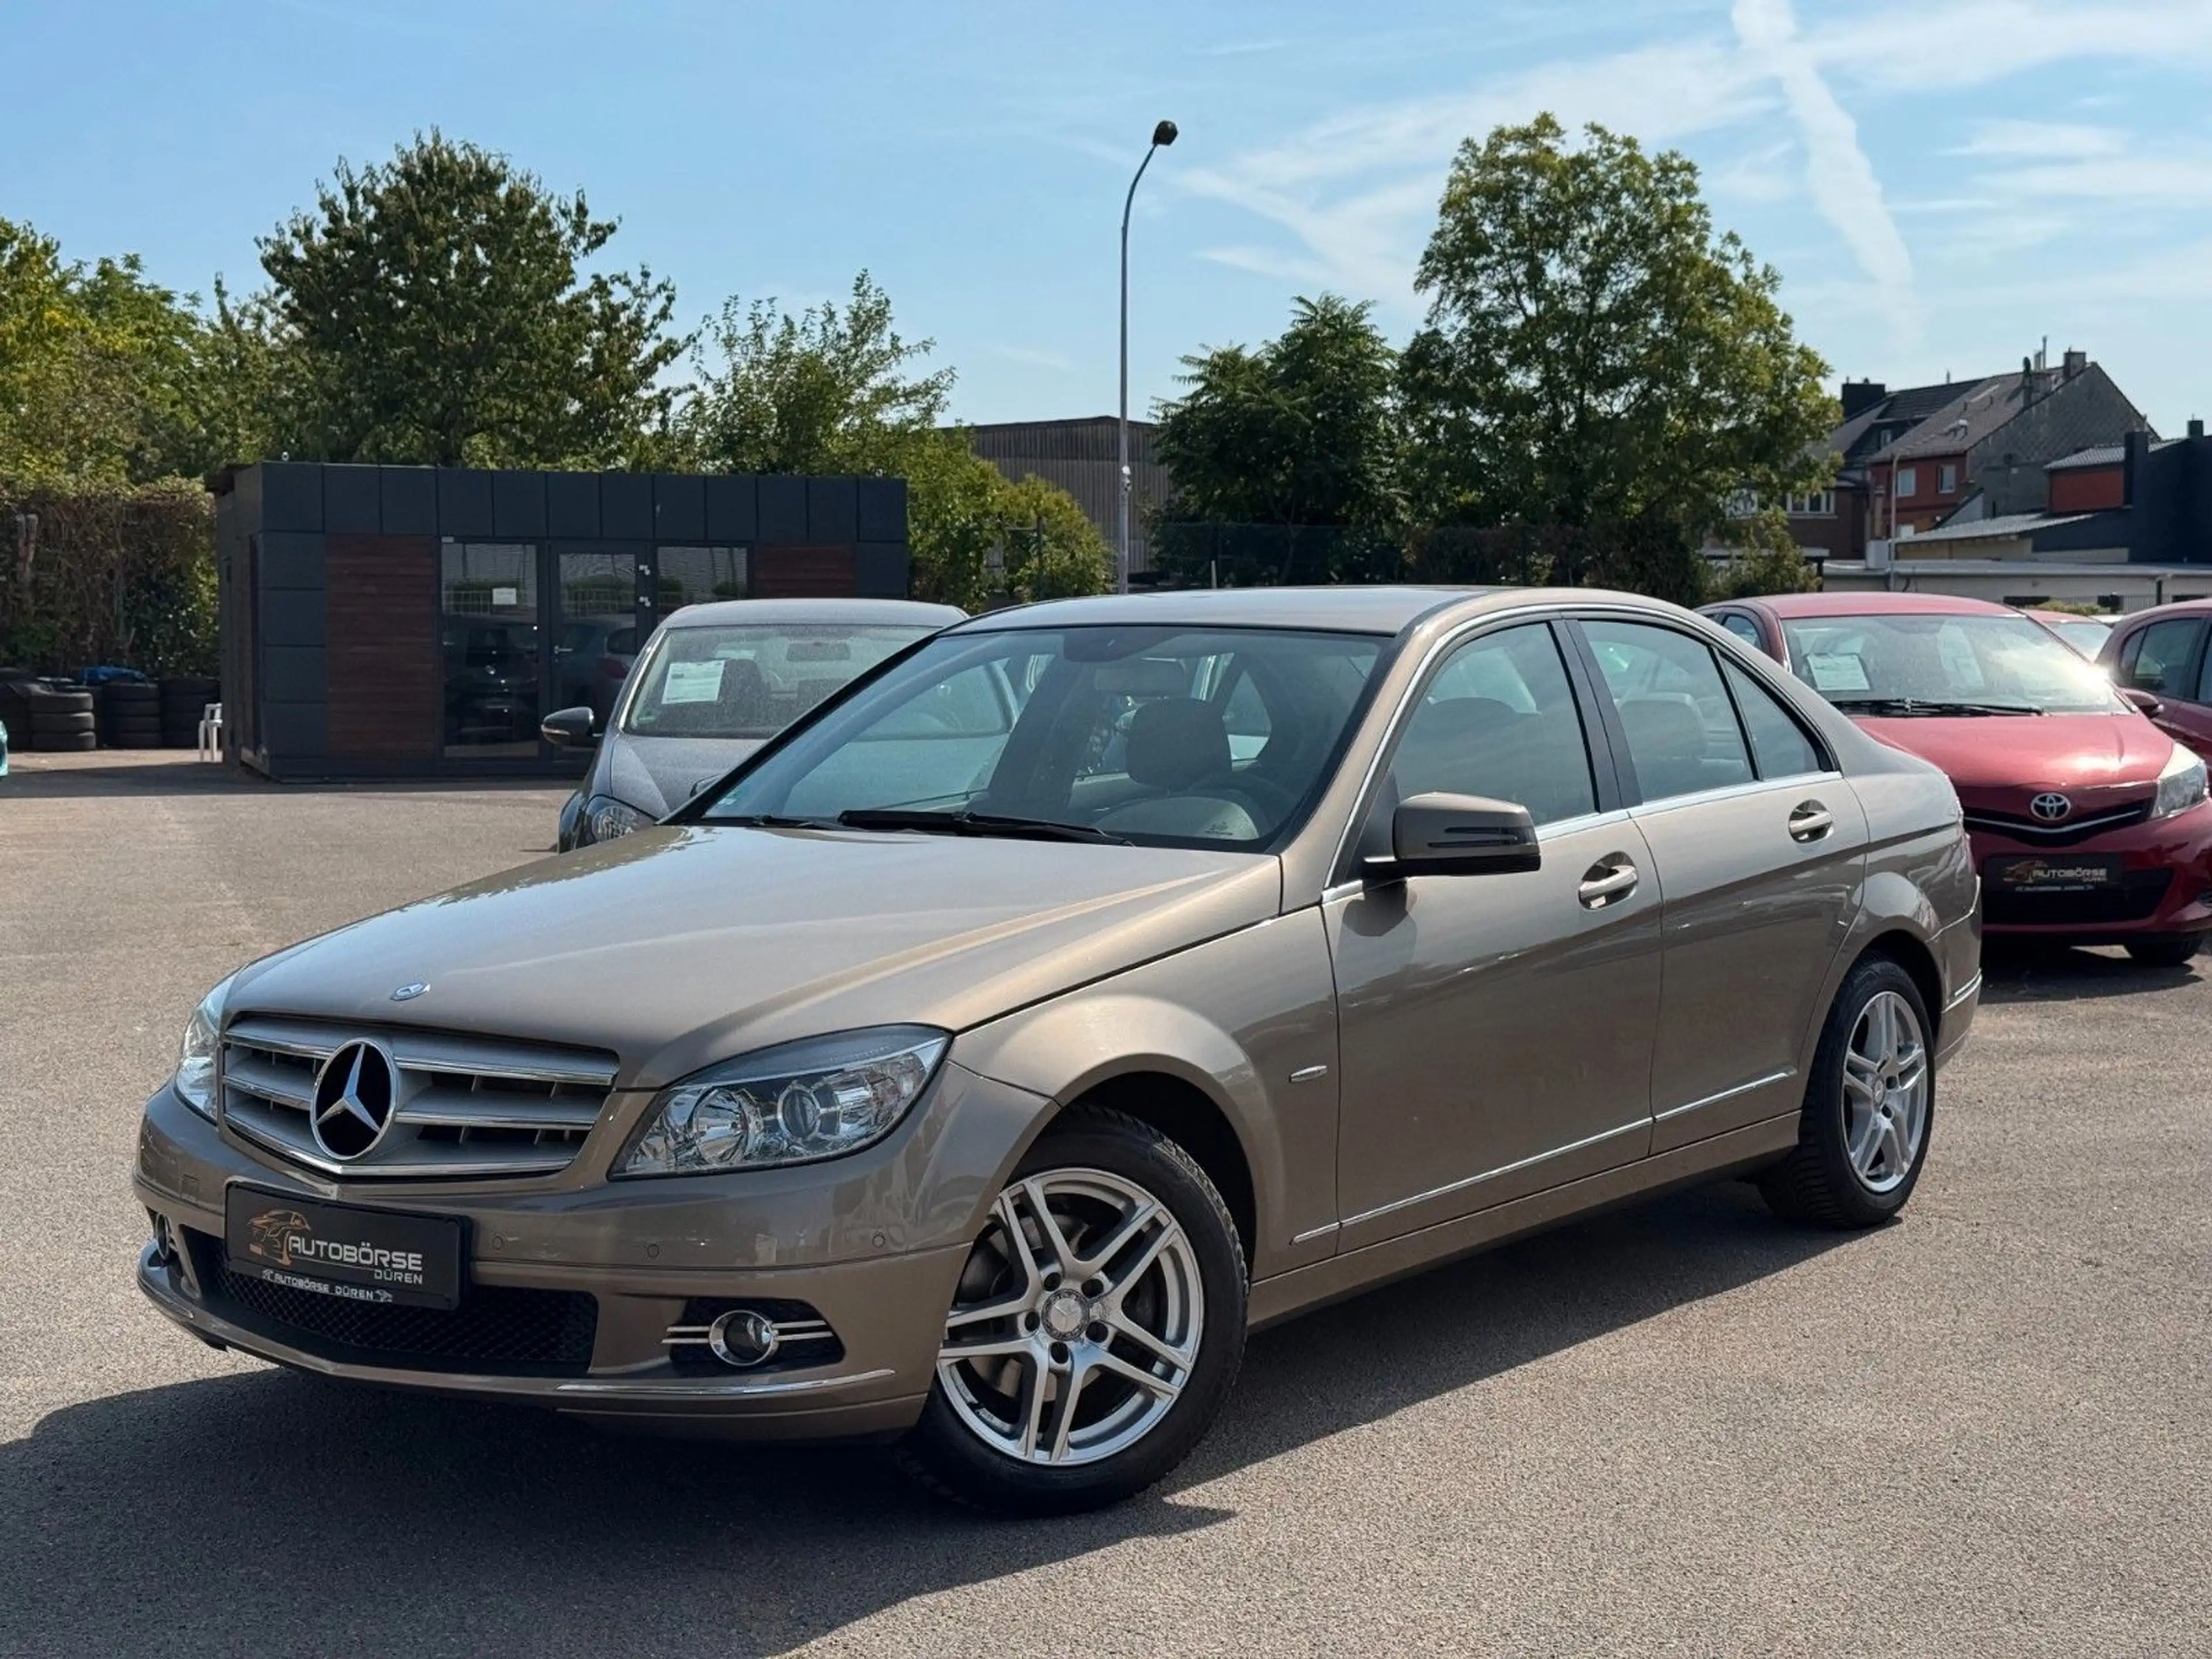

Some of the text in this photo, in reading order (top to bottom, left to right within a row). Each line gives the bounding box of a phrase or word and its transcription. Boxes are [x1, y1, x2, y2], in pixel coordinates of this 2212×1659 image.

[289, 1236, 423, 1271] AUTOBÖRSE
[274, 1273, 373, 1300] AUTOBÖRSE DÜREN
[374, 1268, 423, 1285] DÜREN
